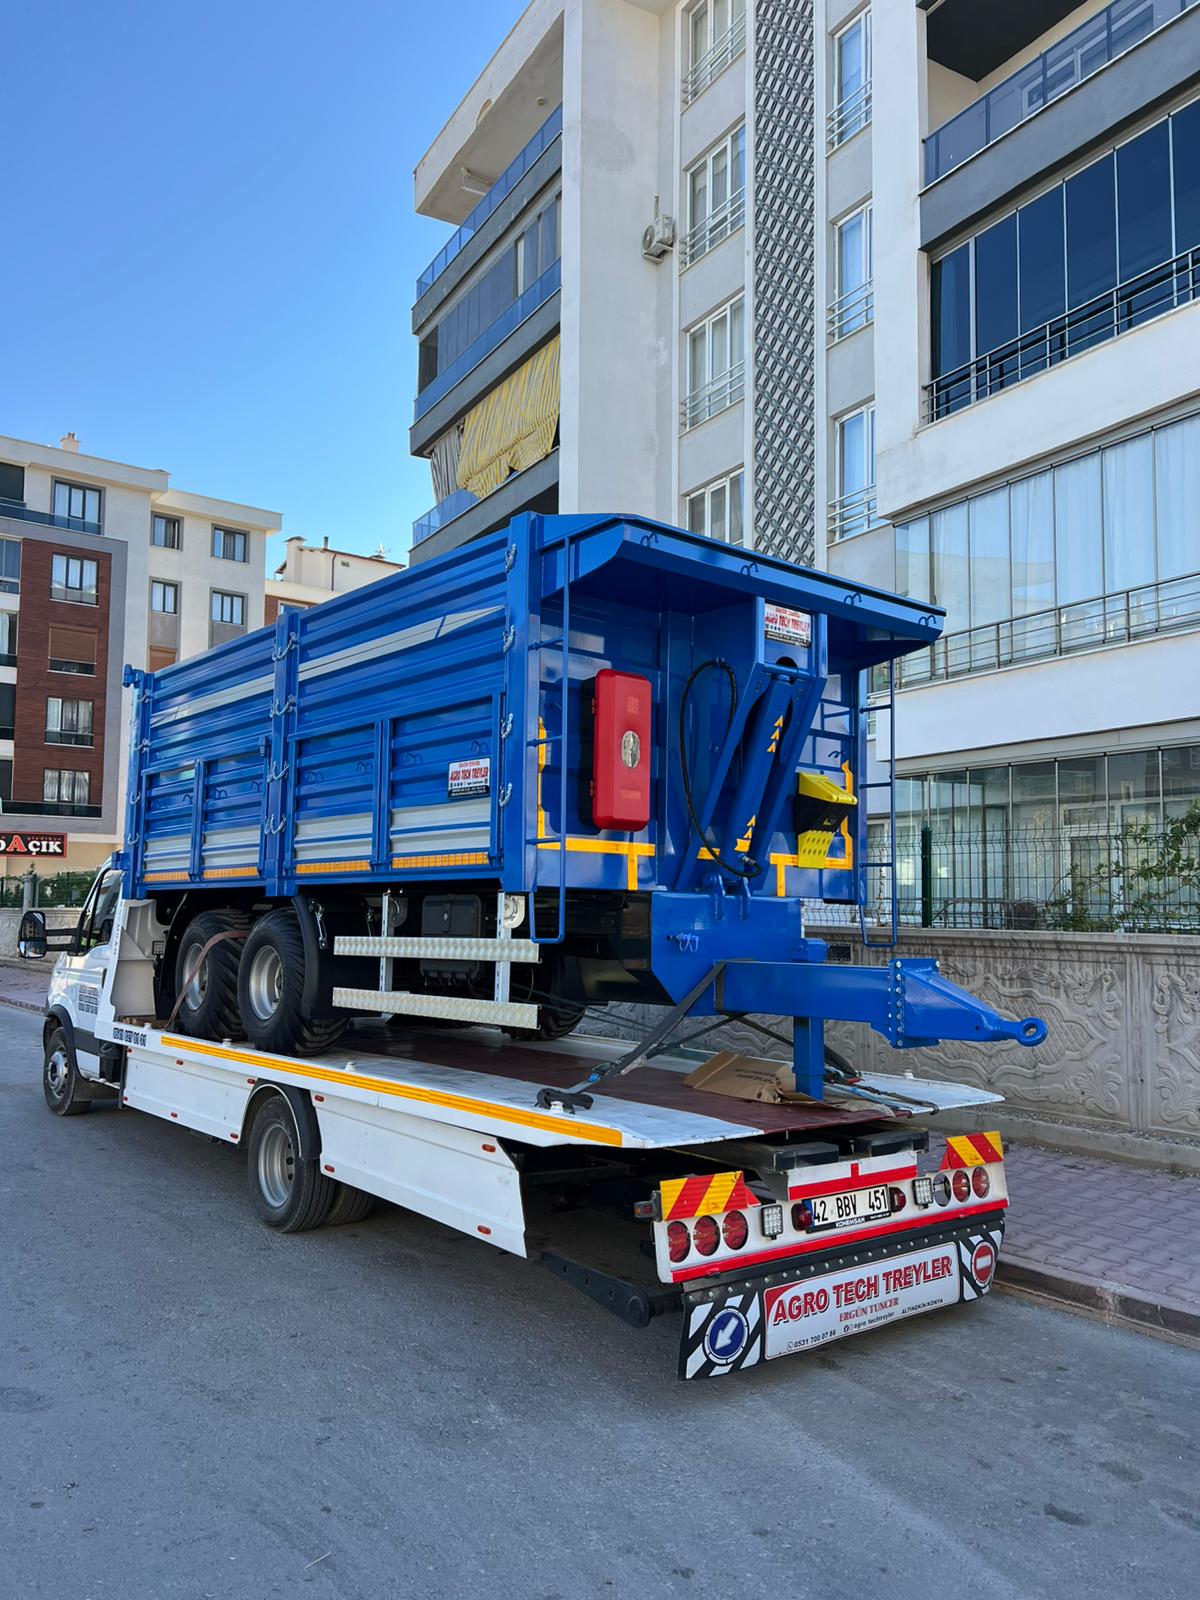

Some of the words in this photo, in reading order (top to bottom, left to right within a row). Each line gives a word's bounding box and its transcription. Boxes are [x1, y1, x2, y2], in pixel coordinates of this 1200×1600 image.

[814, 1200, 829, 1222] 42
[836, 1195, 857, 1218] BBV
[868, 1188, 888, 1211] 451
[835, 1216, 865, 1228] KONEMSAN
[773, 1288, 830, 1326] AGRO
[832, 1275, 879, 1308] TECH
[882, 1256, 953, 1293] TREYLER
[869, 1297, 900, 1315] TUNCER
[793, 1338, 809, 1348] 0531
[811, 1334, 821, 1343] 700
